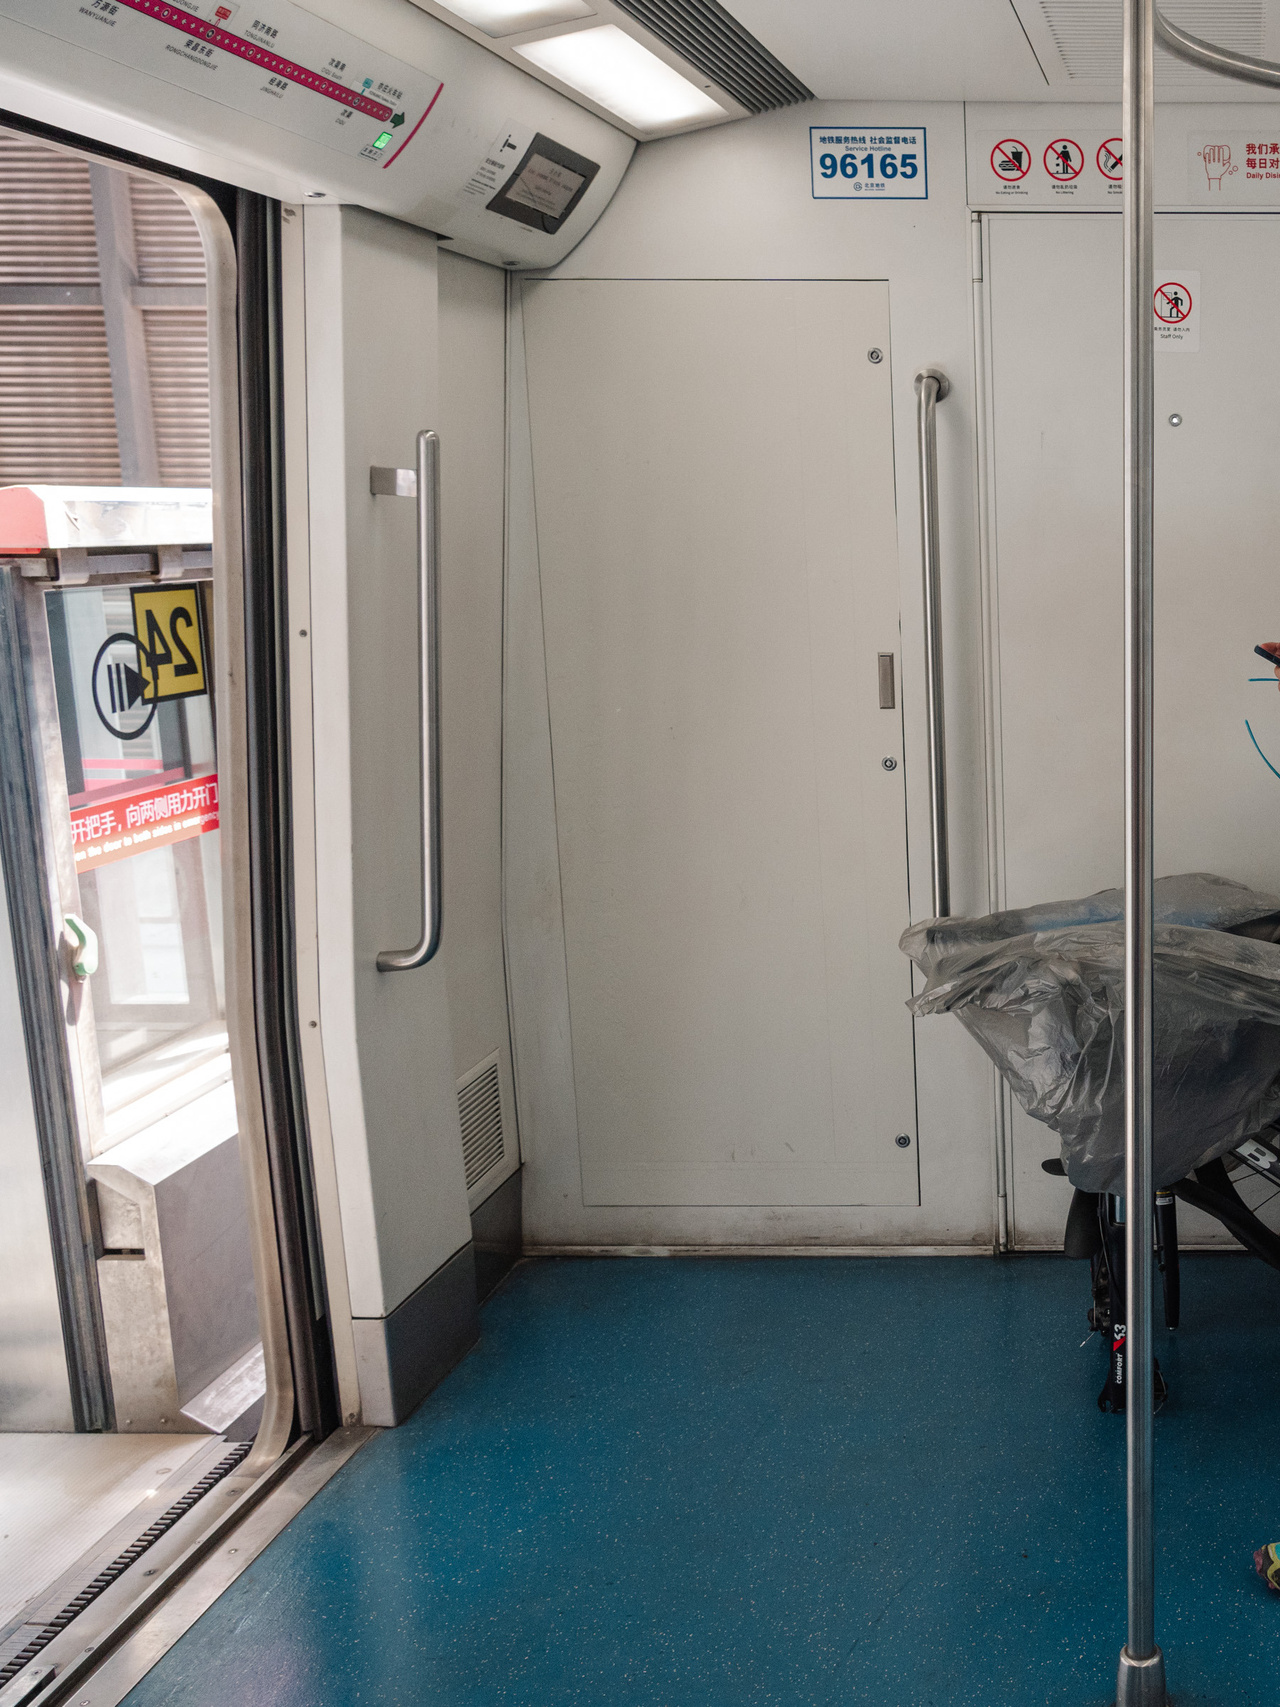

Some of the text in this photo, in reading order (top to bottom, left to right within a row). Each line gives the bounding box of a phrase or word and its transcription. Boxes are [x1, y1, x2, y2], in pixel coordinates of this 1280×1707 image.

[79, 7, 117, 27] WANYUANJIE
[819, 136, 916, 145] 地铁服务热线 社会监督电话
[820, 153, 918, 179] 96165
[1246, 172, 1263, 180] Daily
[71, 783, 218, 845] 开把手，向两侧用力开门
[1115, 1352, 1123, 1385] COMFORT
